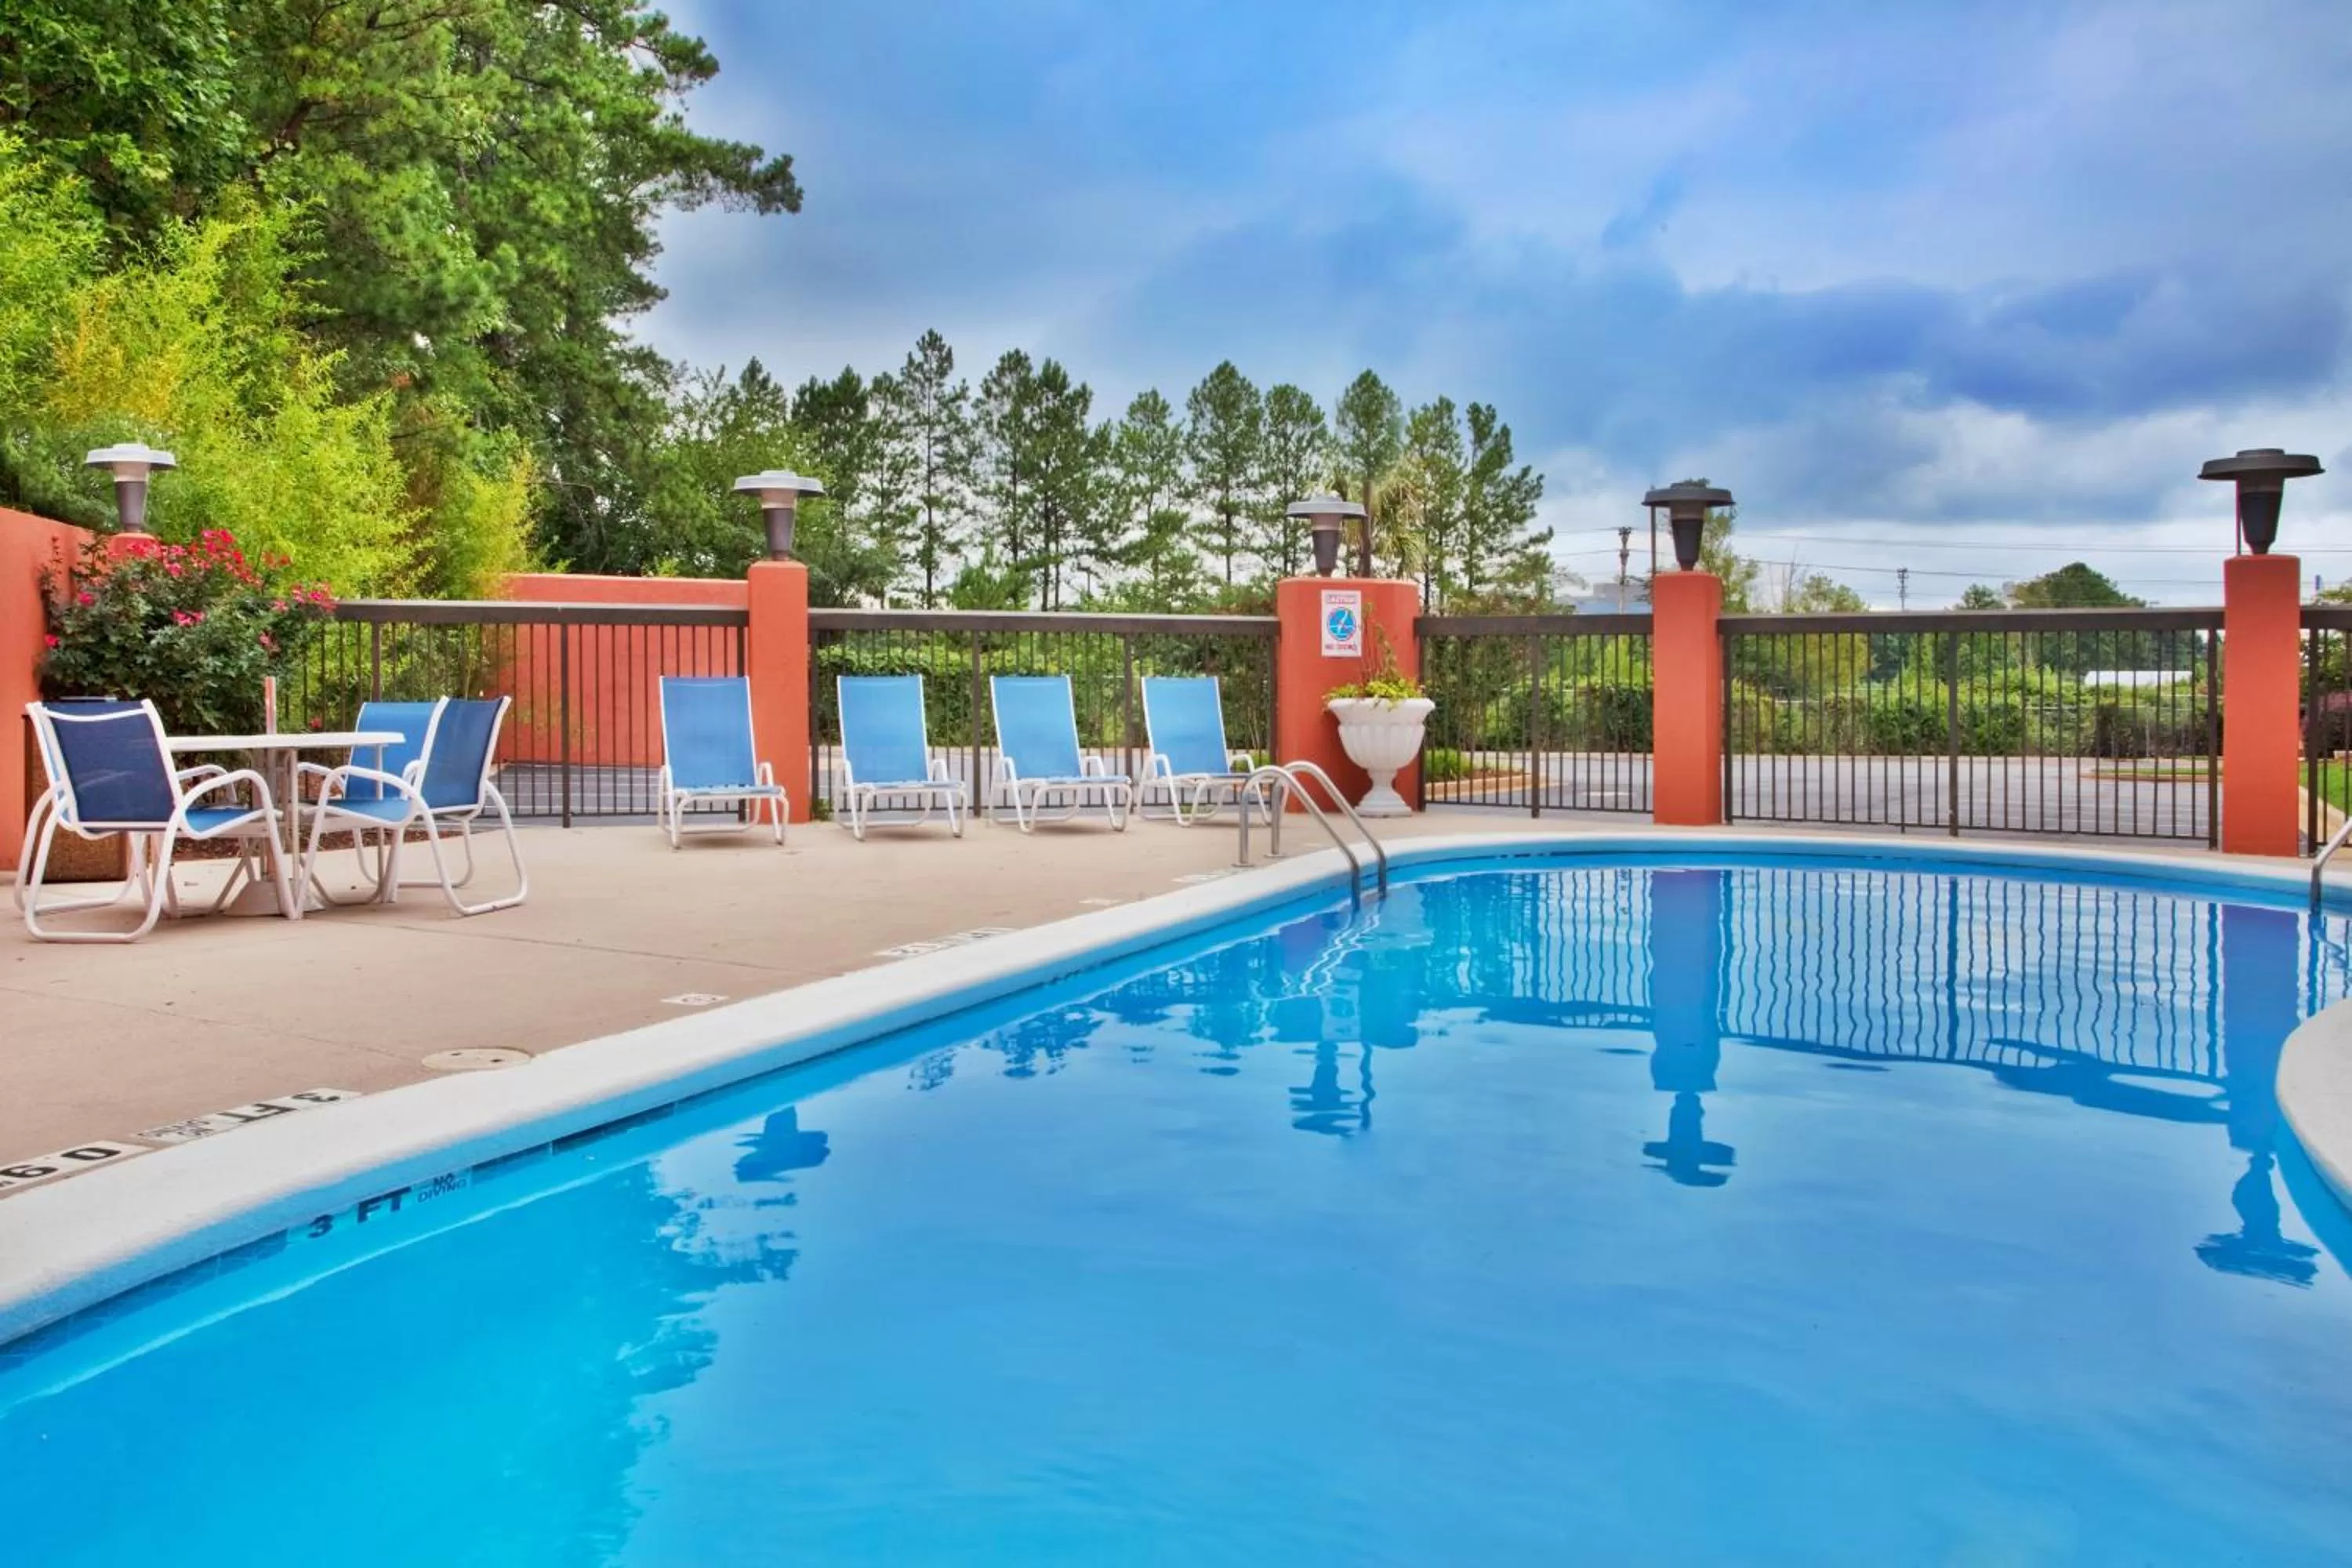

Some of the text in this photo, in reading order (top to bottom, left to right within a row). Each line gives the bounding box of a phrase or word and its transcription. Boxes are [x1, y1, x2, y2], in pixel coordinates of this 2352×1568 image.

[216, 1092, 341, 1123] 3 FT
[307, 1185, 412, 1239] 3 FT
